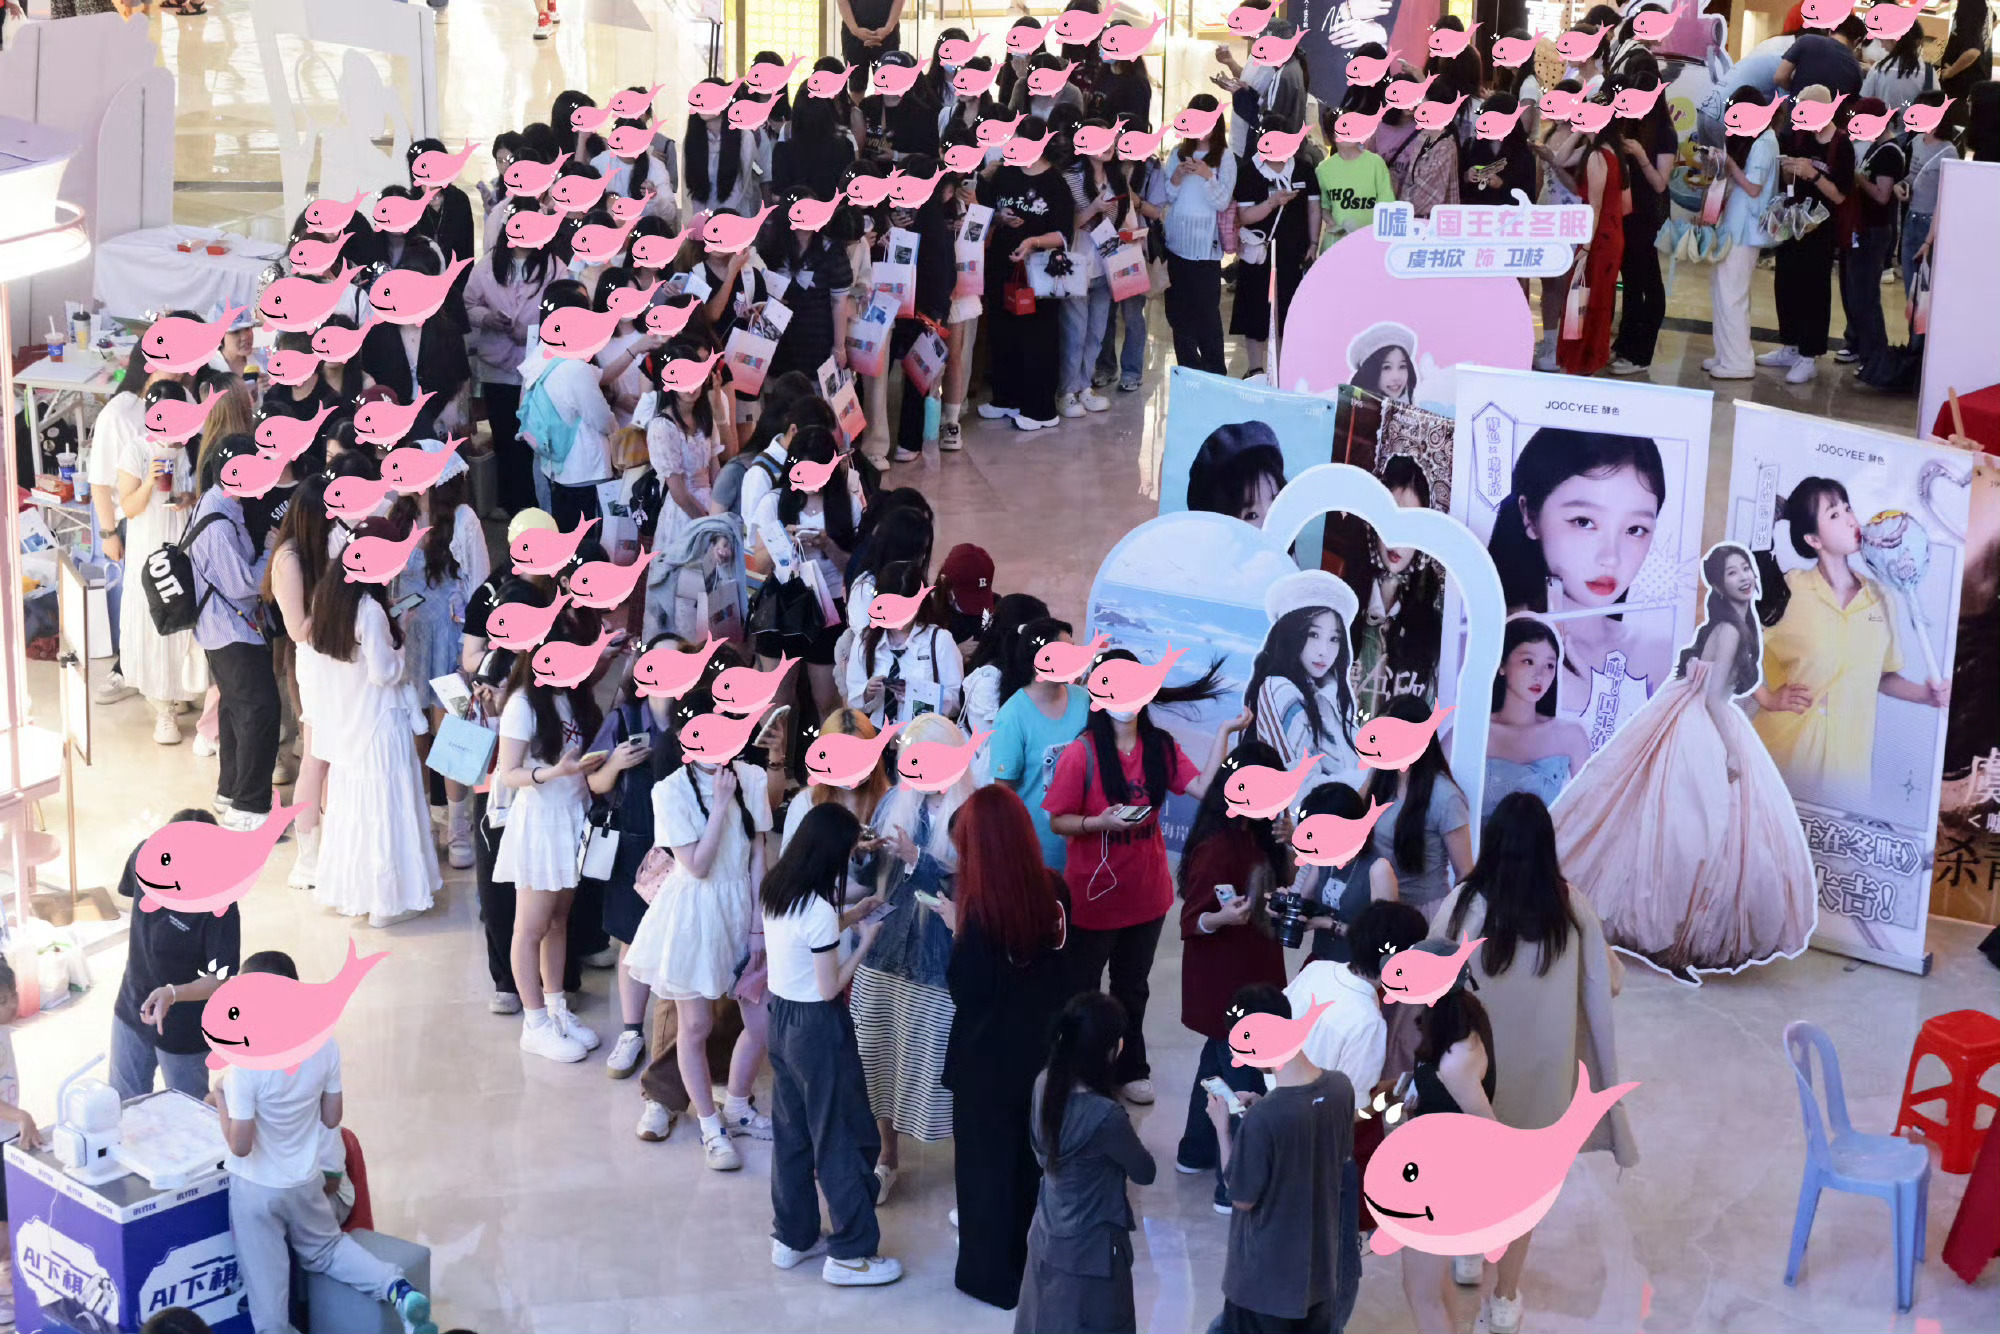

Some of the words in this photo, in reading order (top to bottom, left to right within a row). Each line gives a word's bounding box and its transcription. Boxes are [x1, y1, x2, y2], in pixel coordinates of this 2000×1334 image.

[1407, 248, 1465, 268] 虞书欣
[1504, 248, 1544, 268] 卫枝
[1545, 401, 1598, 414] JOOCYEE
[1815, 443, 1865, 461] JOOCYEE
